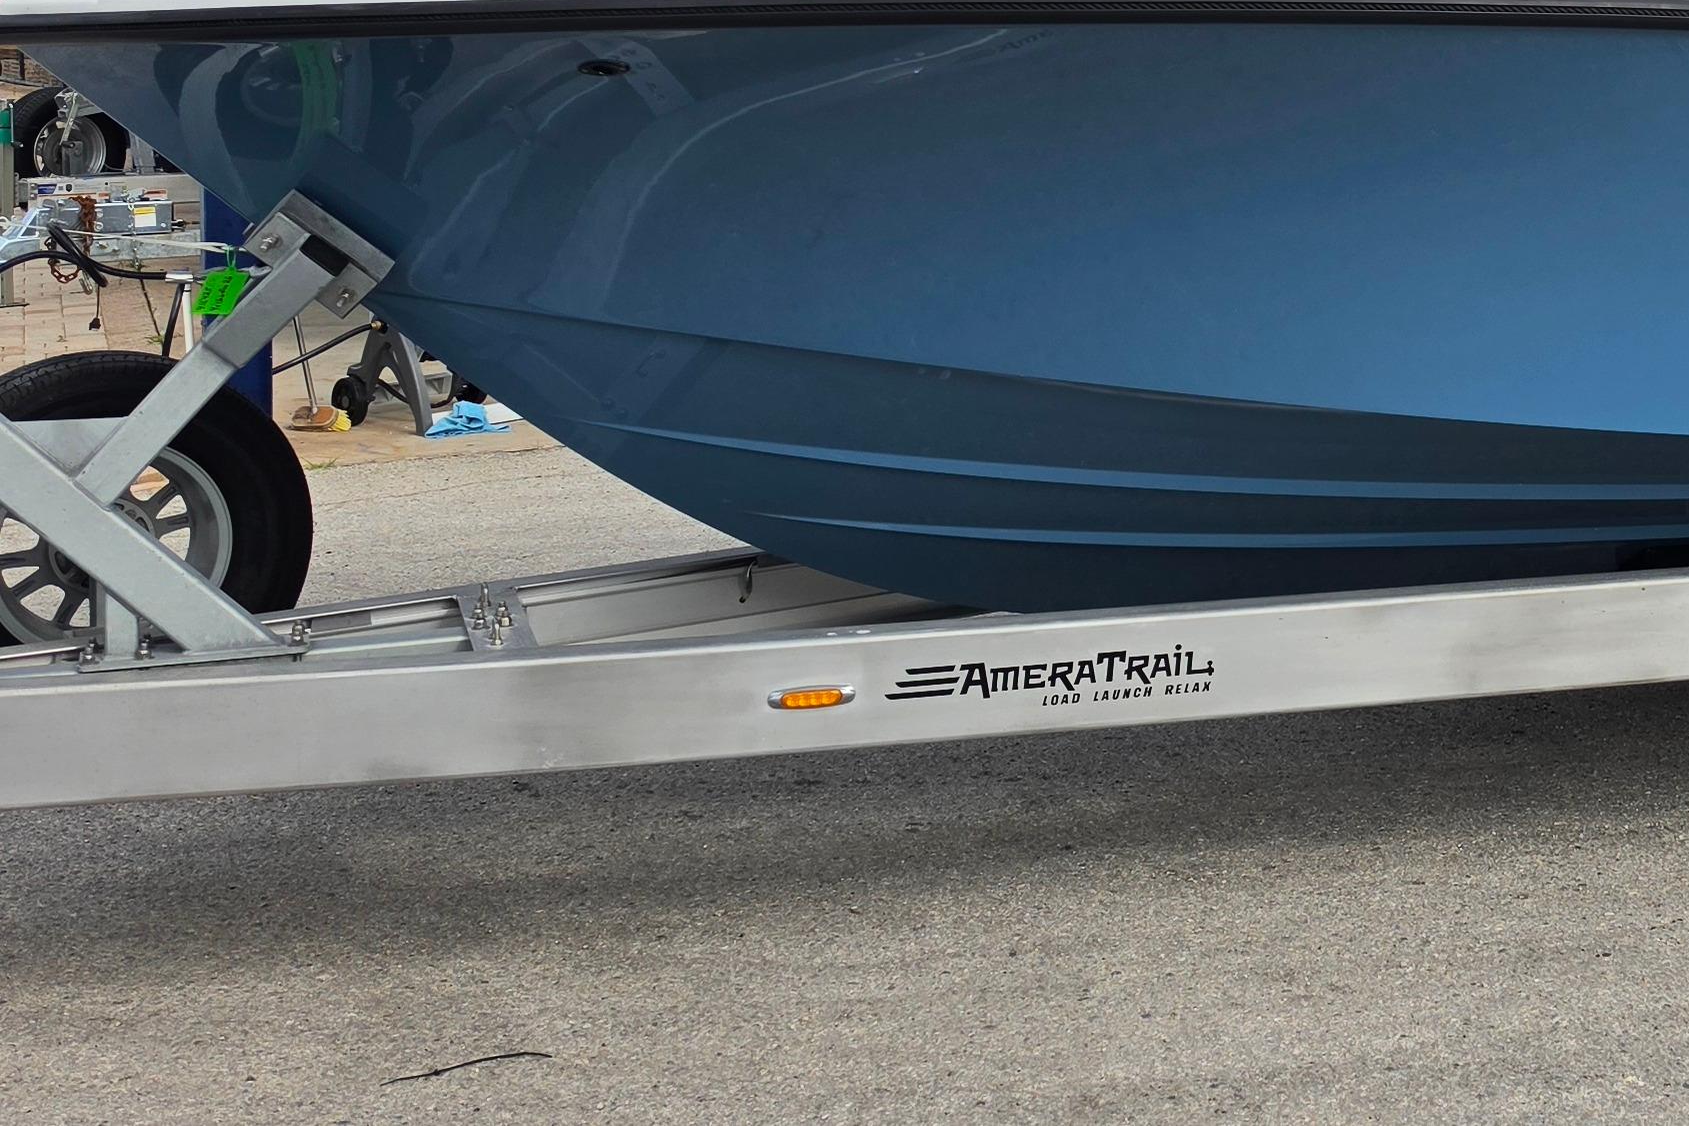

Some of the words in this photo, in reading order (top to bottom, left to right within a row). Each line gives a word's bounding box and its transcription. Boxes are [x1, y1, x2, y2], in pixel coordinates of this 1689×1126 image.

[1042, 693, 1081, 707] LOAD
[1093, 685, 1153, 703] LAUNCH
[1164, 680, 1212, 696] RELAX
